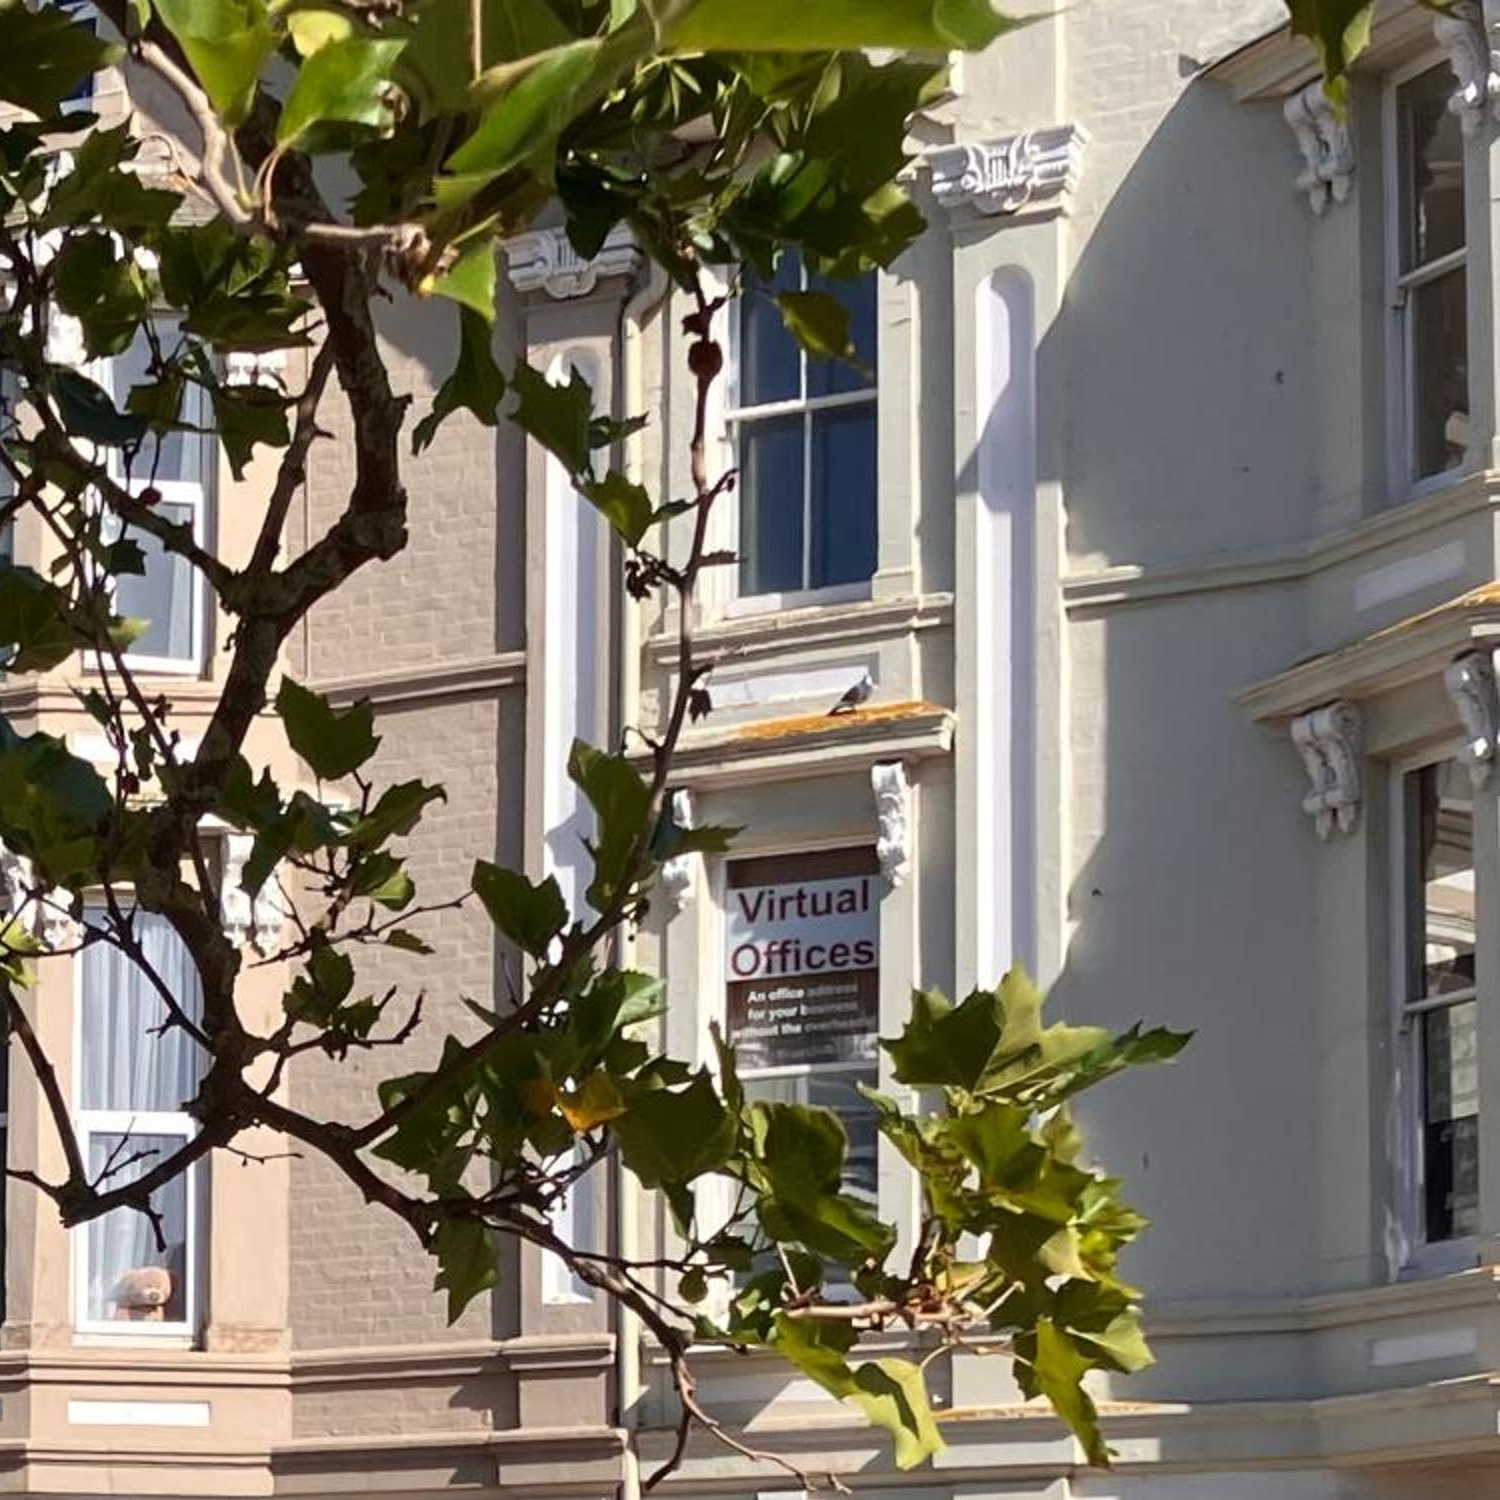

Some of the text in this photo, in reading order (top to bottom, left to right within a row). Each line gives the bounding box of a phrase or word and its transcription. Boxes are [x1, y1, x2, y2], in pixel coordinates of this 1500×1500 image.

[738, 879, 869, 924] Virtual
[731, 939, 875, 977] Offices
[747, 991, 766, 1003] An
[768, 987, 804, 999] office
[748, 1007, 765, 1020] for
[768, 1007, 798, 1022] your
